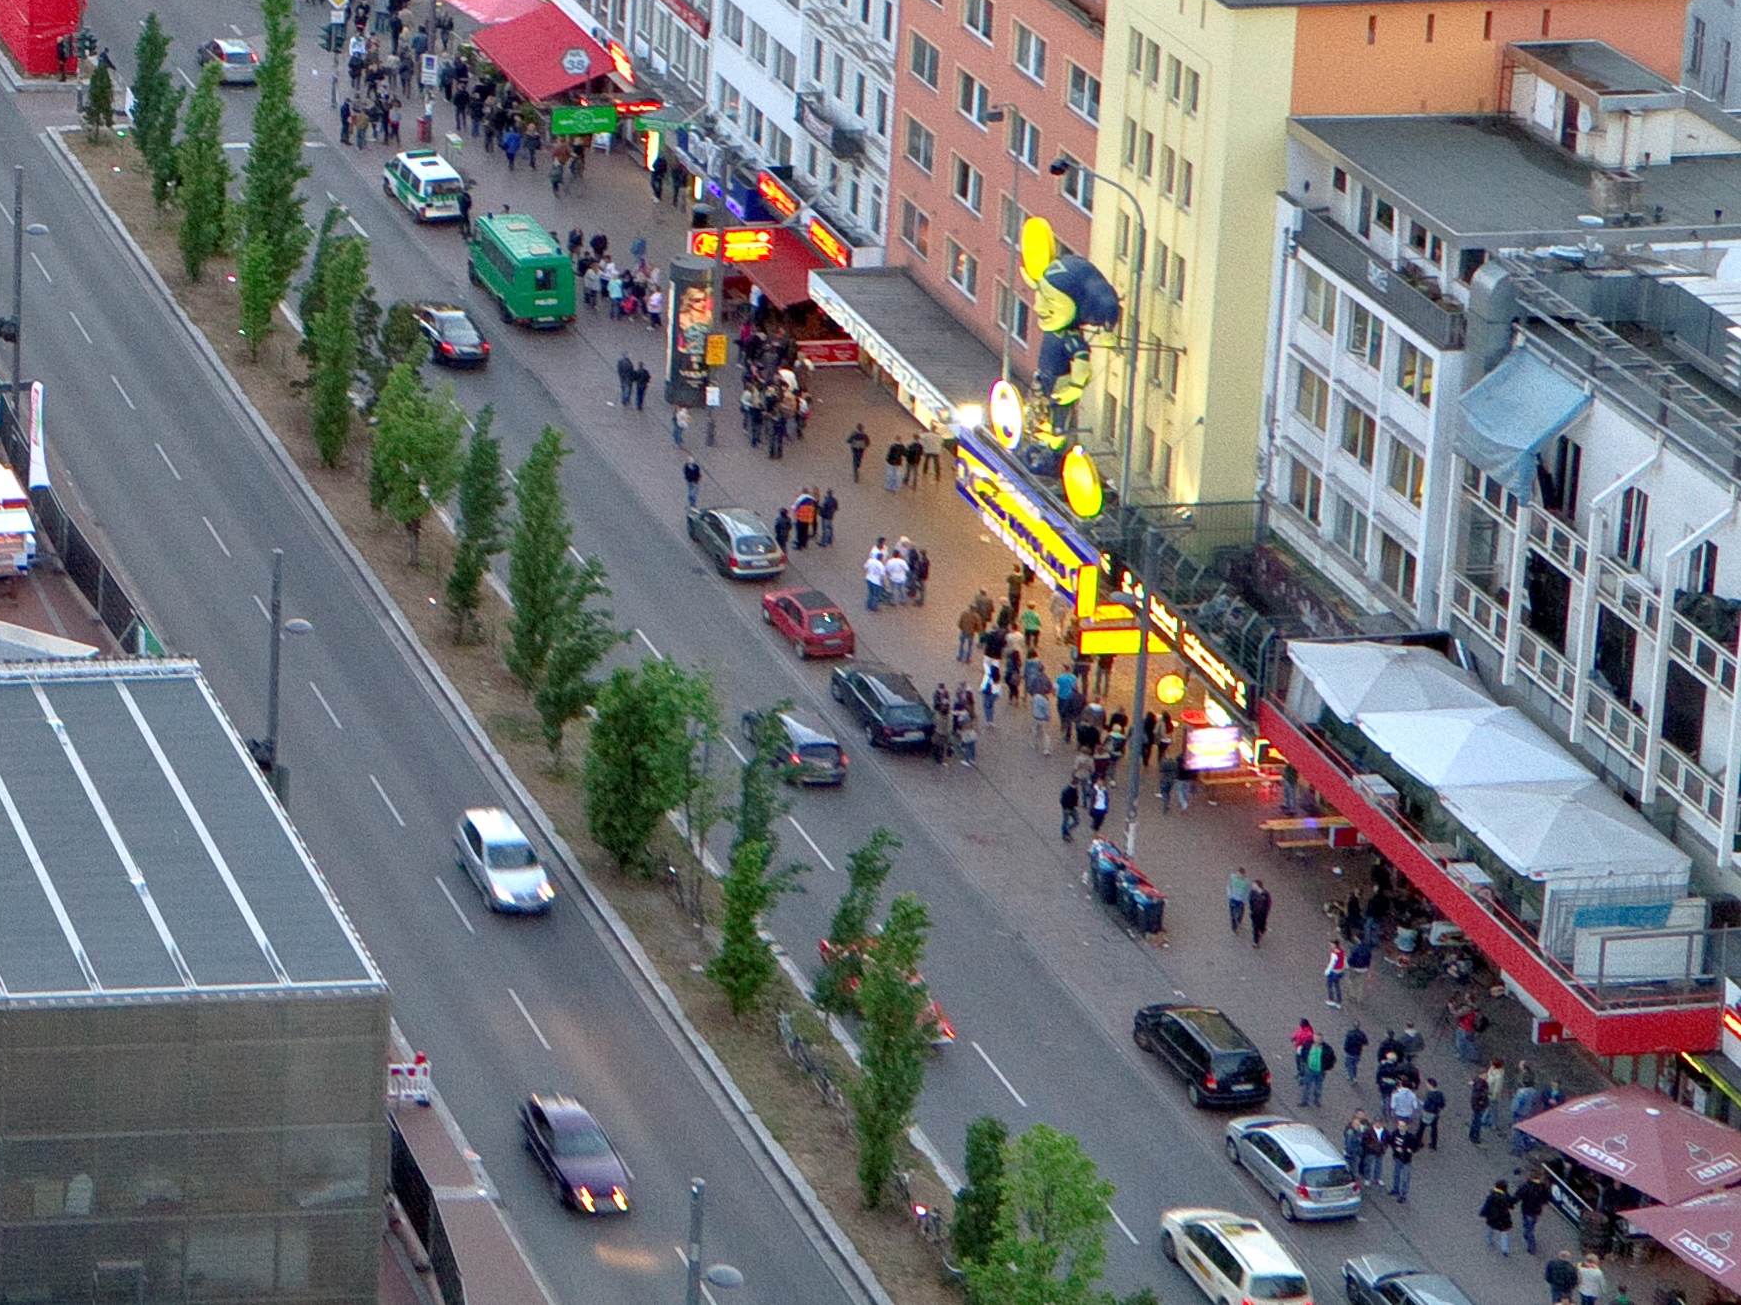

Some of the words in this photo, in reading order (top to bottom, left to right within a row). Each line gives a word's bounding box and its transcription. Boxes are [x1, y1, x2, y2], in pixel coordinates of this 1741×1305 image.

[1576, 1143, 1627, 1172] ASTRA
[1696, 1158, 1738, 1180] ASTRA
[1678, 1236, 1726, 1269] ASTRA
